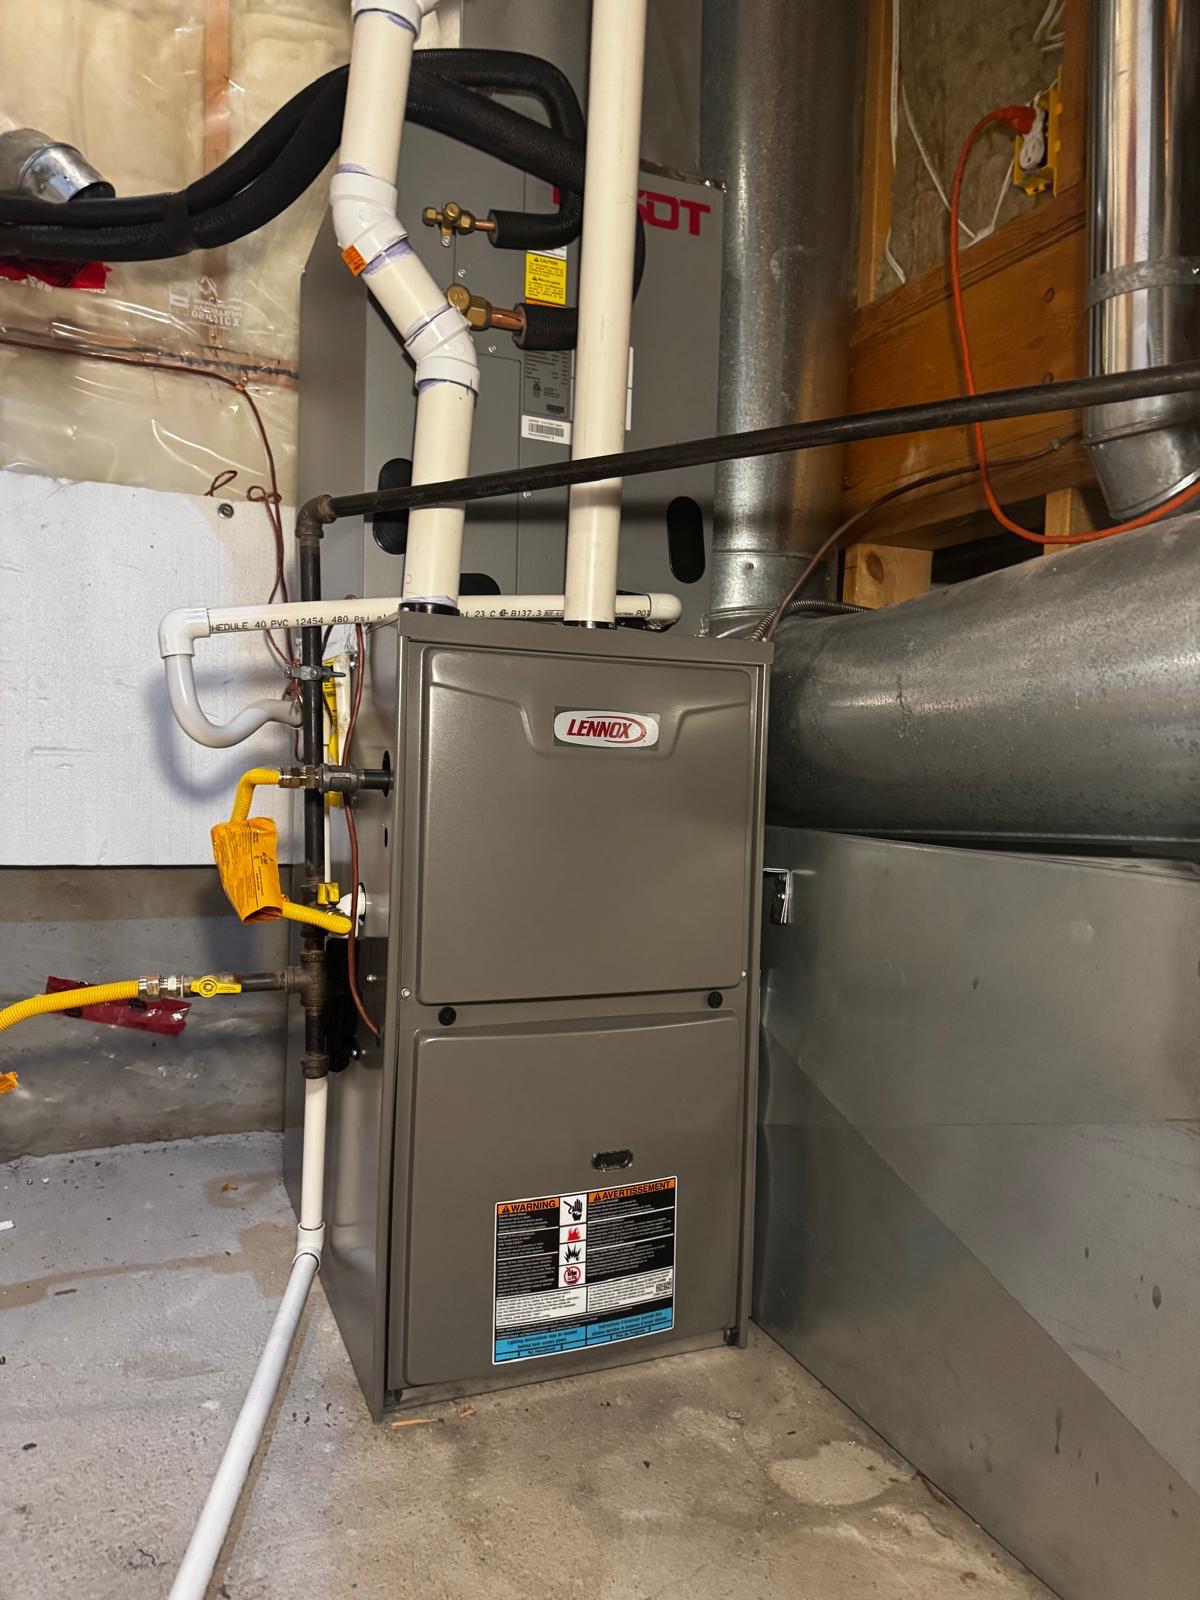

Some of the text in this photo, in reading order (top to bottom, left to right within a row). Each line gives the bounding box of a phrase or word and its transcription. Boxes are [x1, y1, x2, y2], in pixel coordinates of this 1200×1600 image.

[209, 621, 249, 632] HEDULE
[254, 620, 267, 629] 40
[270, 619, 289, 628] PVC
[295, 617, 324, 626] 12454
[331, 615, 349, 624] 480
[474, 610, 485, 618] 23
[510, 609, 542, 617] B137.3
[566, 718, 633, 739] LENNOX
[602, 1180, 671, 1200] AVERTISSEMENT
[511, 1199, 556, 1212] WARNING
